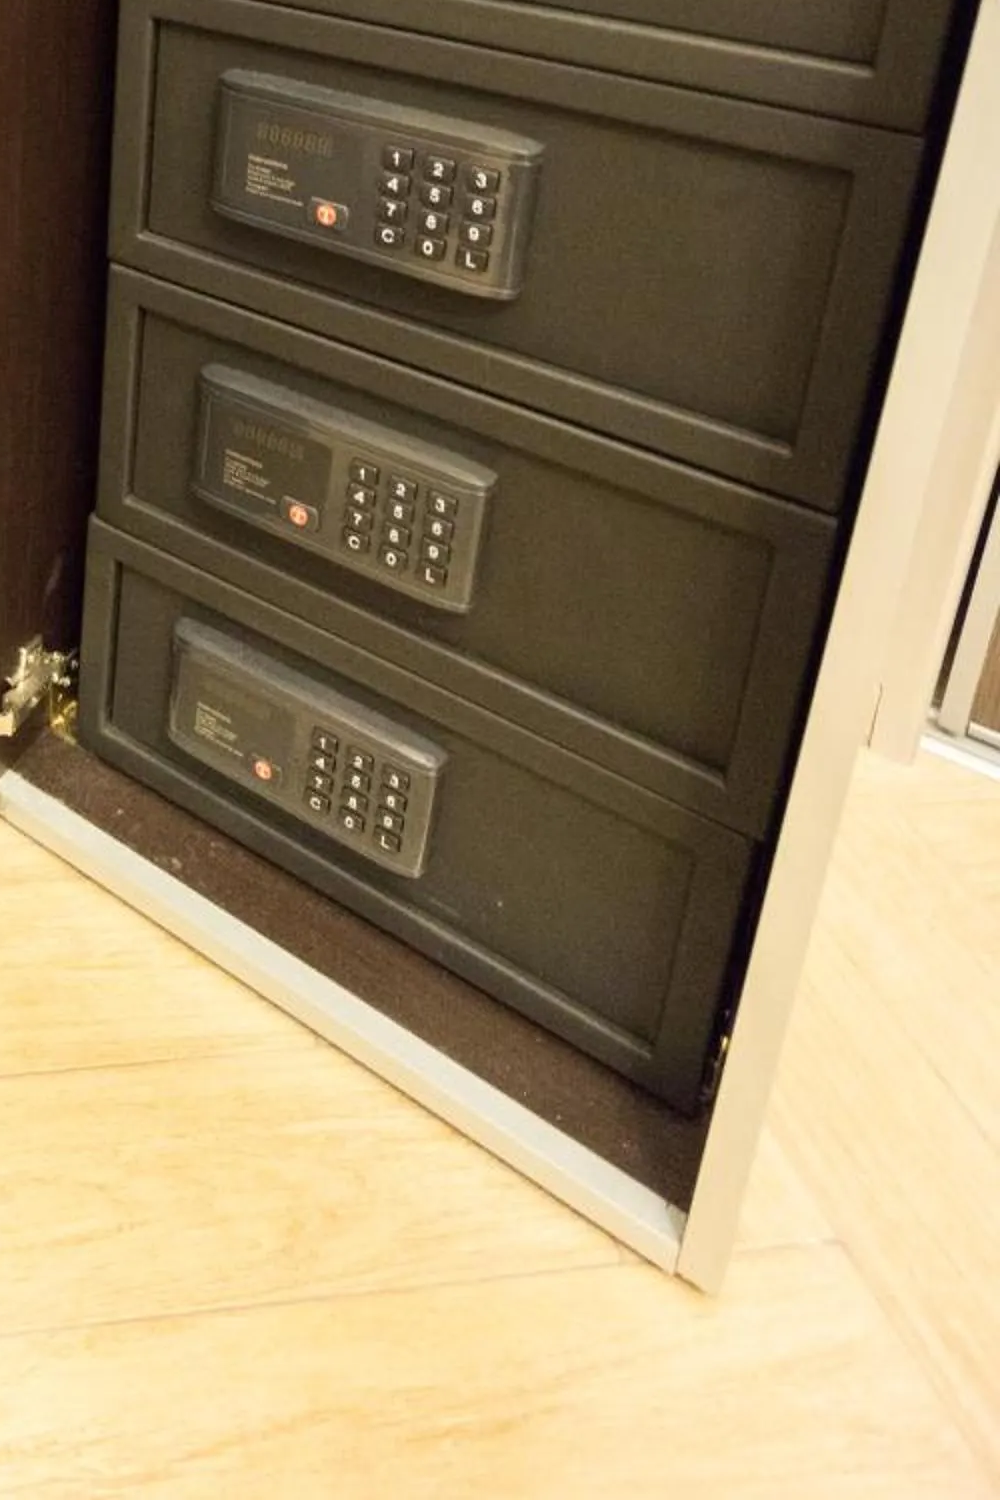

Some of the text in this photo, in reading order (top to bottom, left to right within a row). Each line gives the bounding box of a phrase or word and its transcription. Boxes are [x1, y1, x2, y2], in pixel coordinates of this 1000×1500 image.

[386, 176, 399, 192] 4
[429, 187, 441, 203] 5
[432, 161, 444, 178] 2
[475, 171, 487, 189] 3
[386, 201, 397, 217] 7
[468, 226, 480, 241] 9
[422, 239, 434, 256] 0
[465, 251, 476, 269] L
